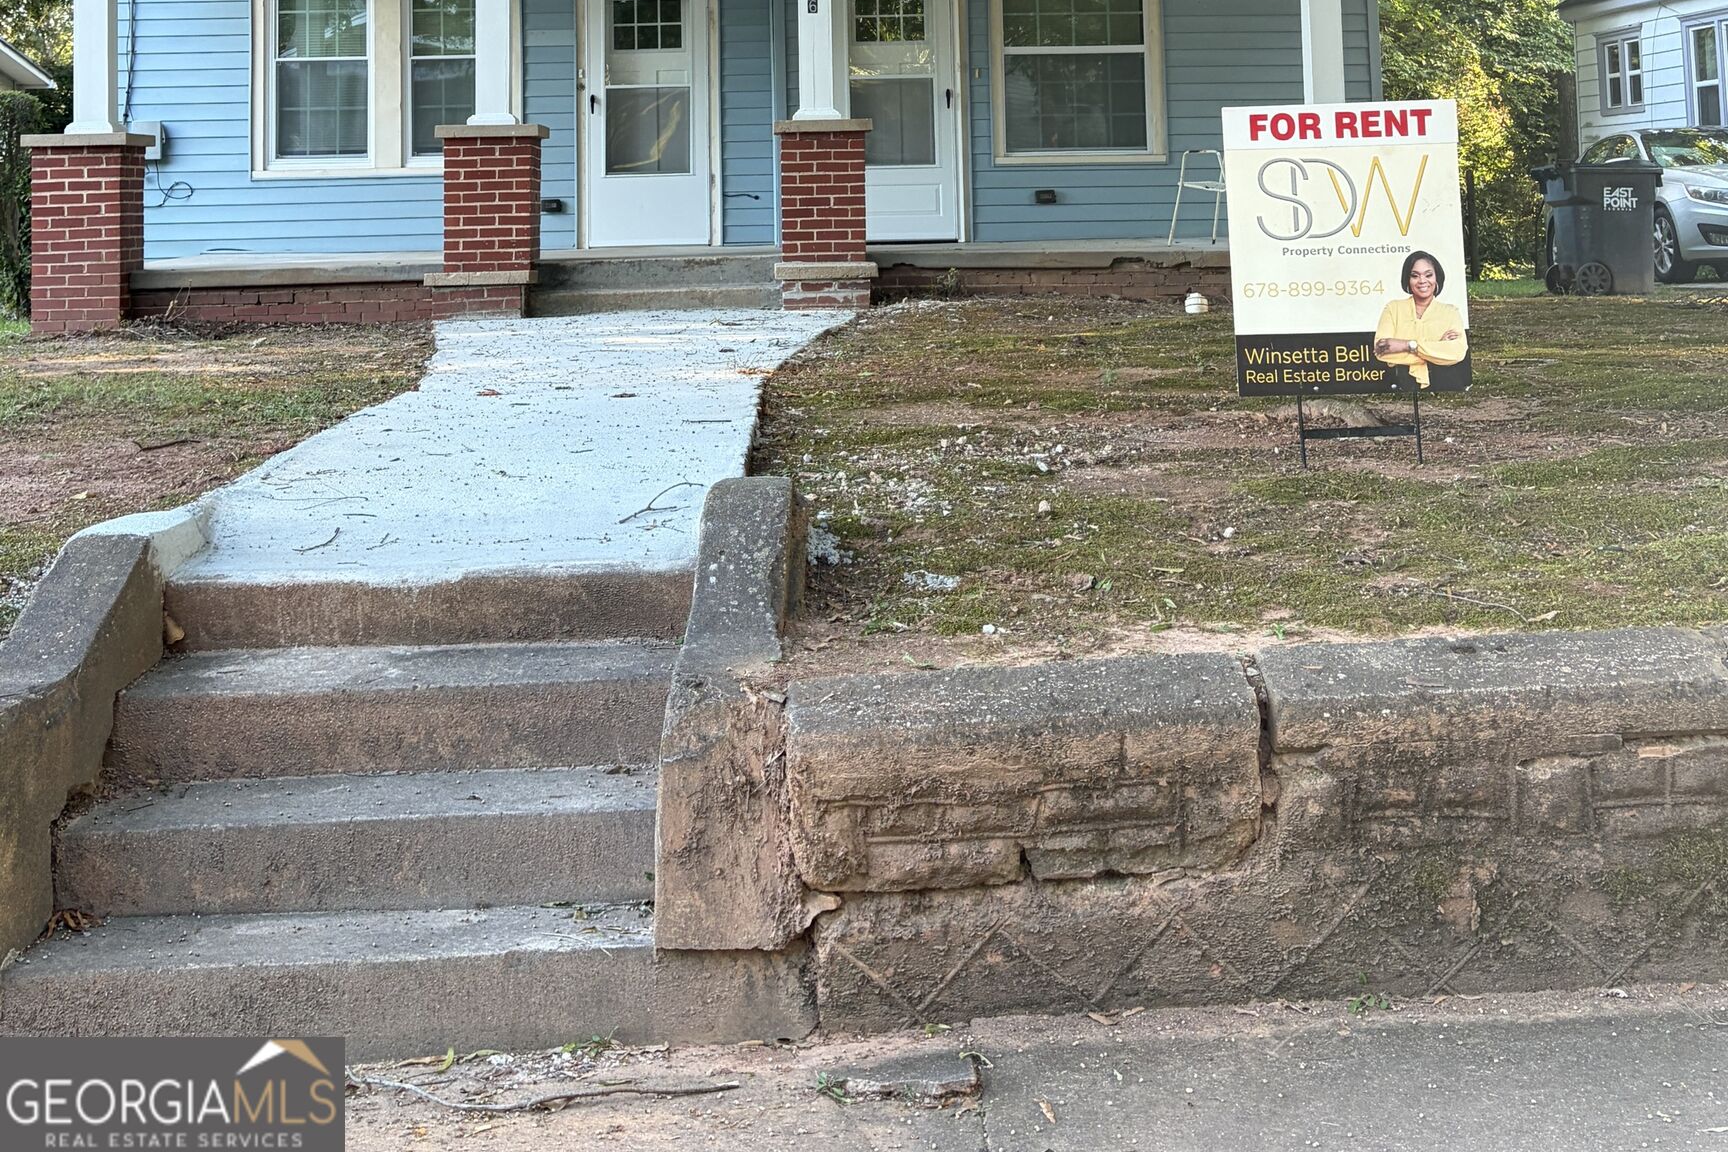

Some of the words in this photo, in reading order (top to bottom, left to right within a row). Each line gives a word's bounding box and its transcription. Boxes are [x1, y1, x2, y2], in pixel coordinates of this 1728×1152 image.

[1249, 112, 1322, 141] FOR
[1334, 108, 1432, 140] RENT
[1256, 154, 1429, 241] SDW
[1603, 186, 1634, 198] EAST
[1603, 197, 1639, 209] POINT
[1281, 246, 1334, 258] Property
[1337, 243, 1412, 255] Connections
[1242, 279, 1385, 299] 678-899-9364
[1244, 346, 1329, 365] Winsetta
[1335, 345, 1370, 364] Bell
[1245, 369, 1278, 384] Real
[1283, 368, 1331, 384] Estate
[1335, 367, 1386, 383] Broker
